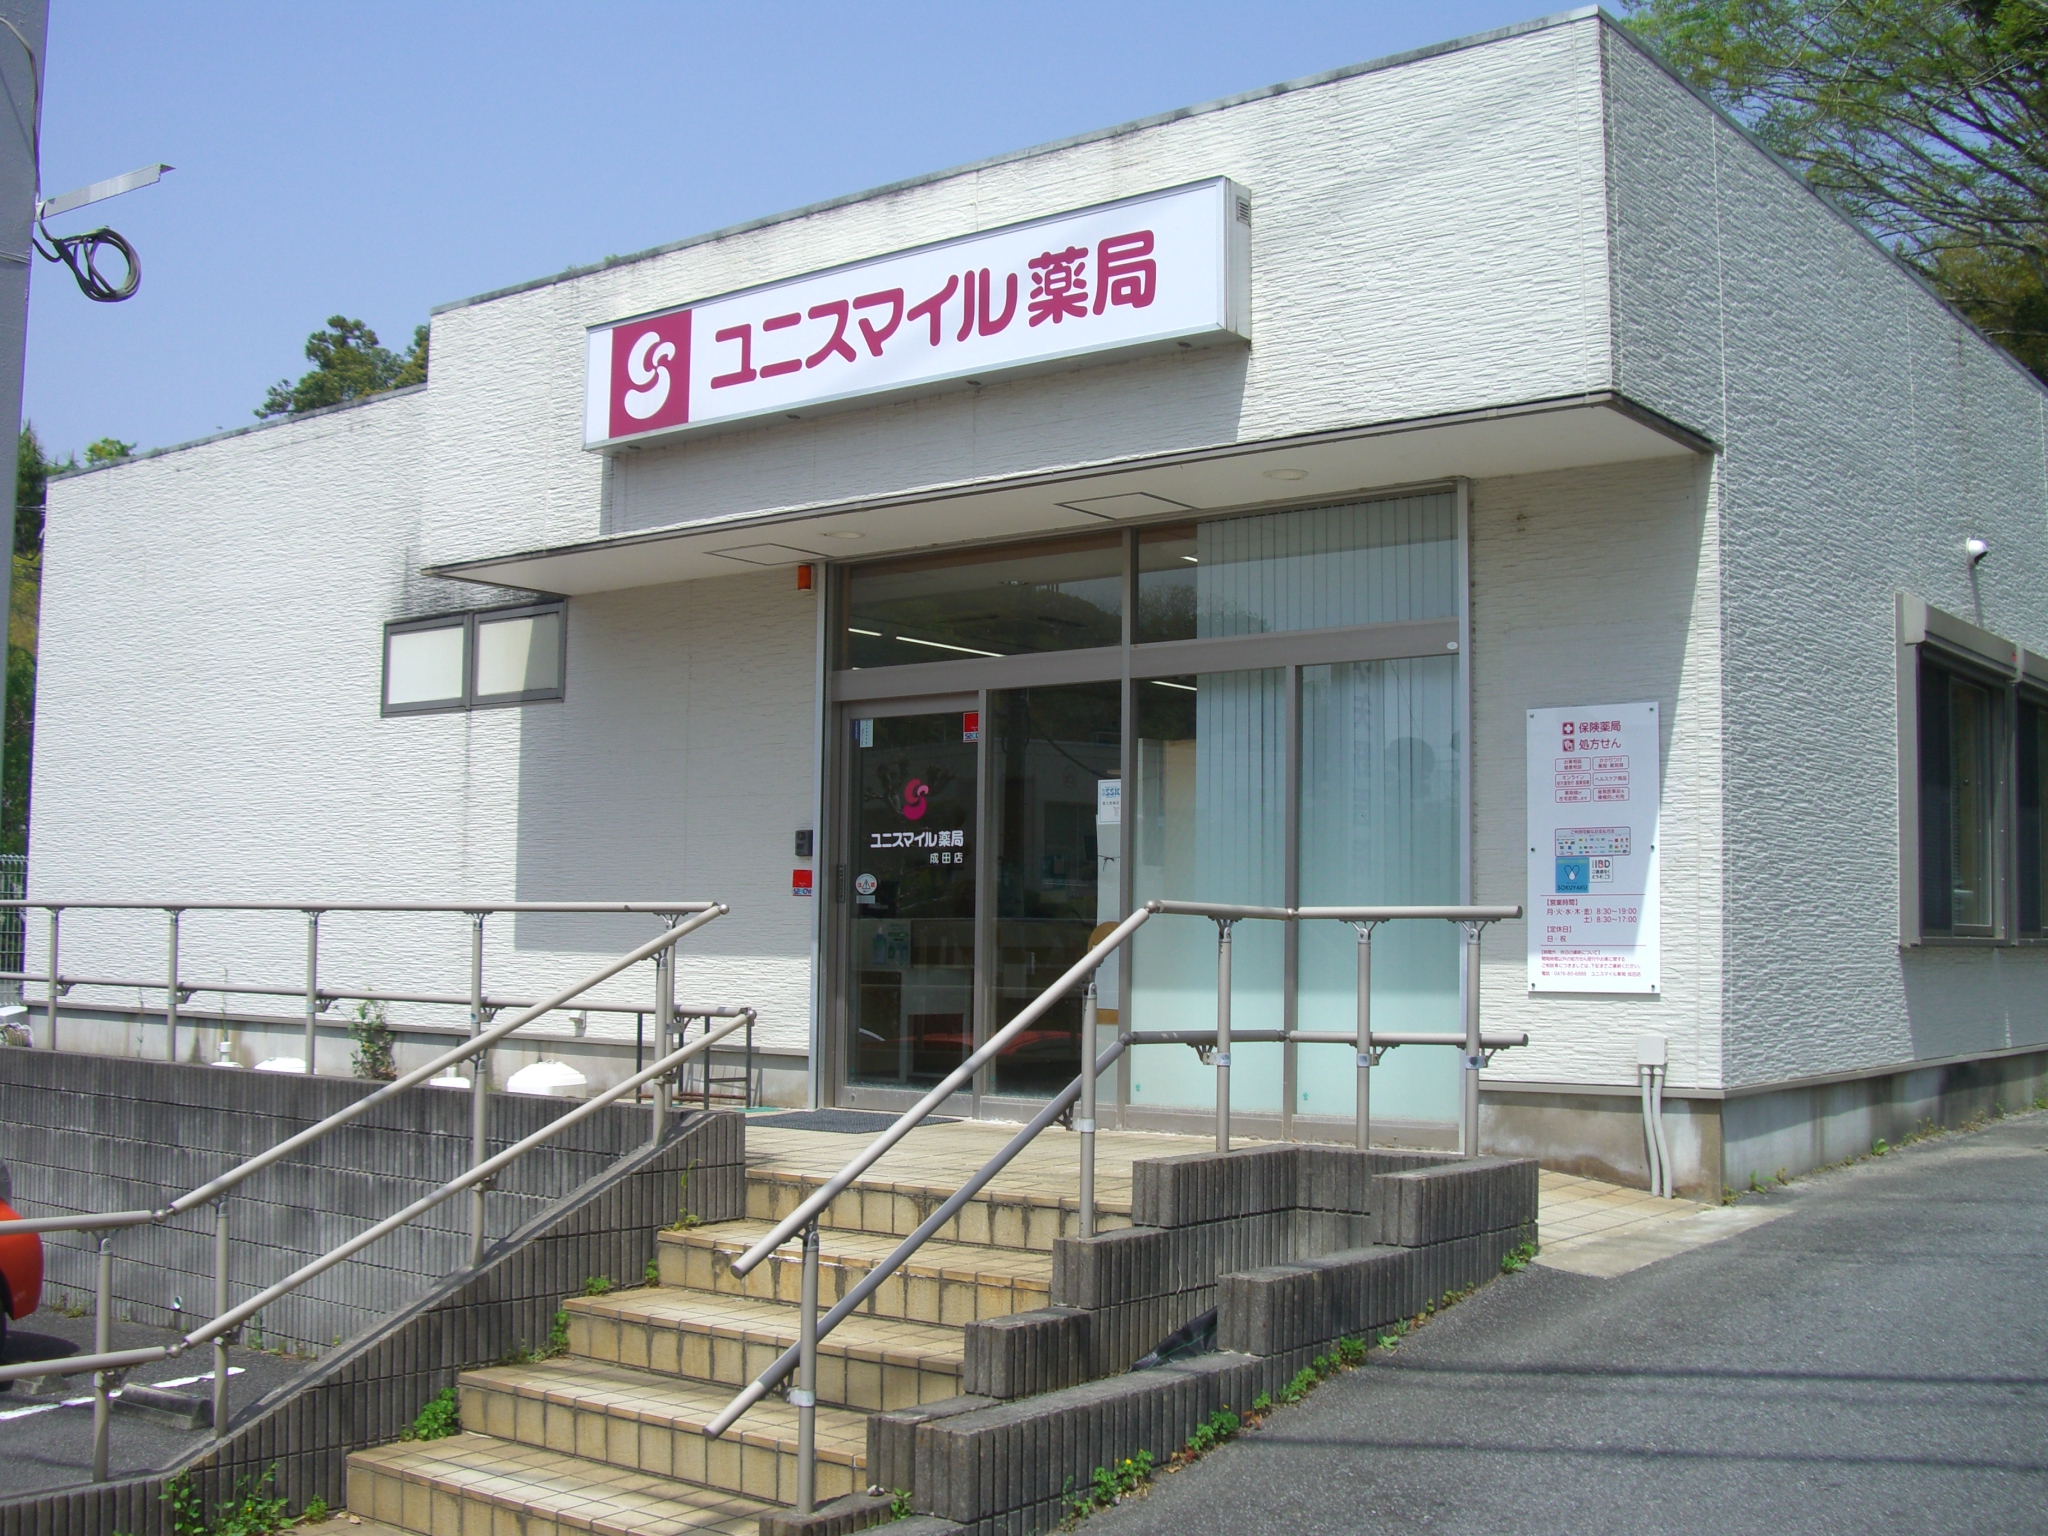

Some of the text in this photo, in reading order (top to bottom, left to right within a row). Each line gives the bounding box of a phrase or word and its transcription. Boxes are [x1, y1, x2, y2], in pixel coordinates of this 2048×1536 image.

[710, 229, 1157, 390] ユニスマイル薬局
[1578, 721, 1621, 733] 保険薬局
[1578, 739, 1621, 750] 処方せん
[870, 830, 964, 848] ユニスマイル薬局
[930, 852, 963, 864] 成田店
